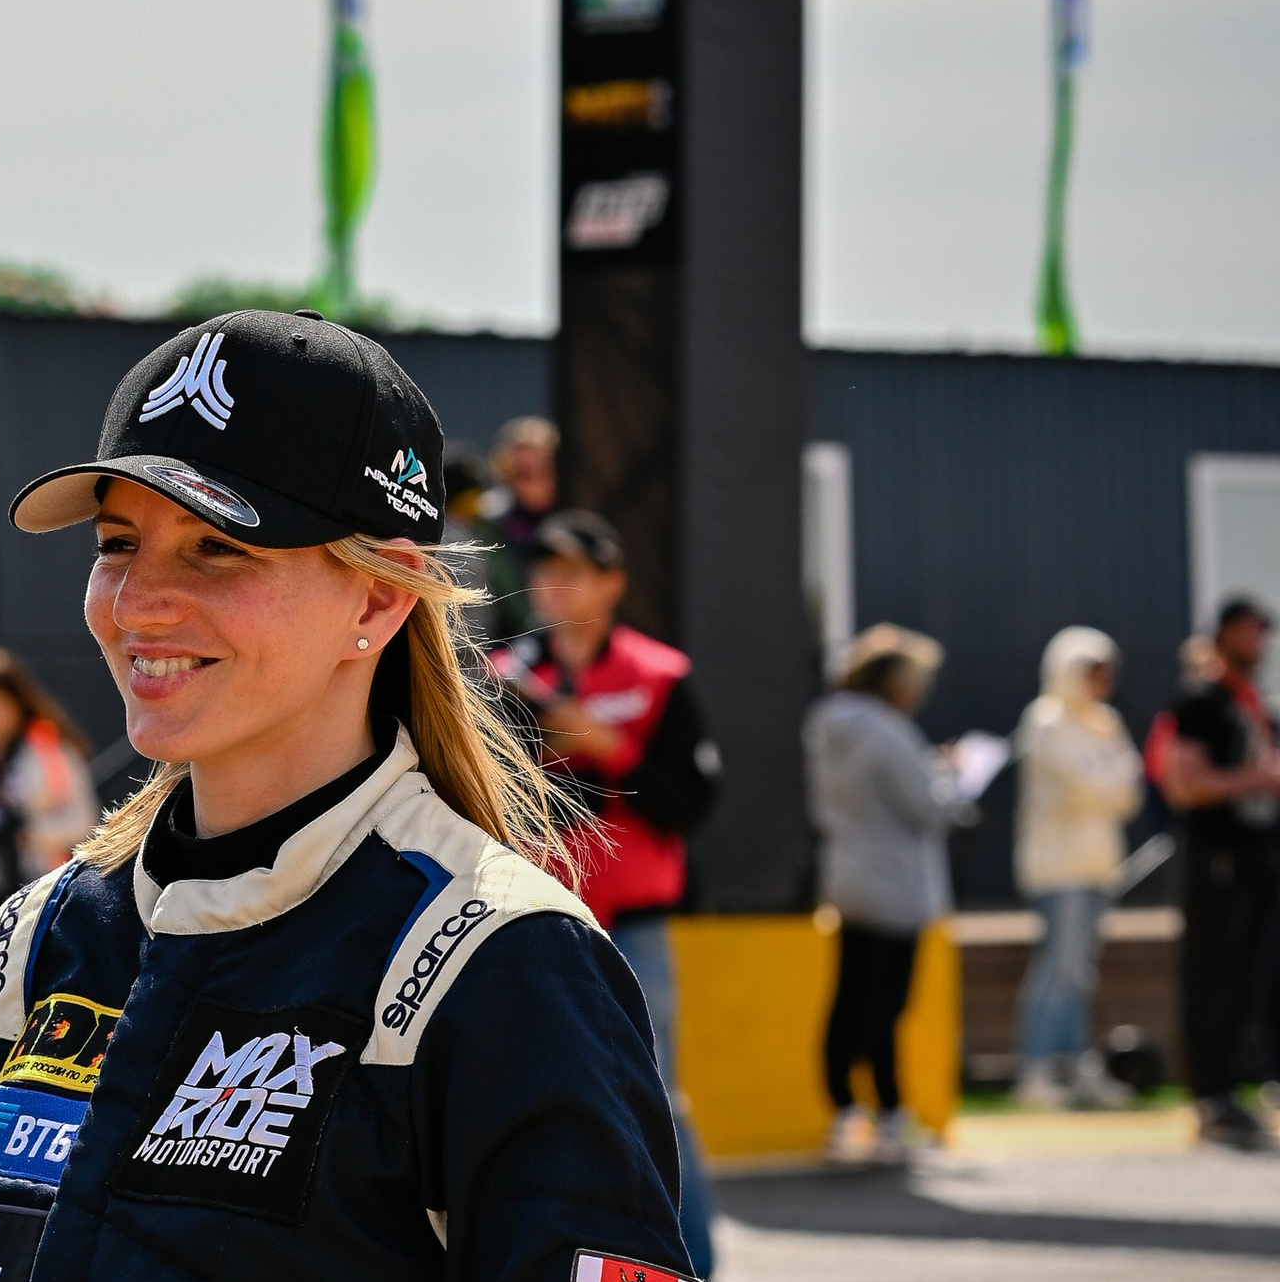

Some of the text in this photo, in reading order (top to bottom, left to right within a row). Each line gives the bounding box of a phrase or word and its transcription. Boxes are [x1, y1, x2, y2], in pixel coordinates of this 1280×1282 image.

[364, 466, 439, 520] NIGHT RACER
[386, 492, 421, 522] TEAM
[381, 898, 493, 1034] sparco
[183, 1030, 347, 1096] MAX
[4, 1115, 80, 1162] ВТБ
[132, 1133, 282, 1178] MOTORSPORT
